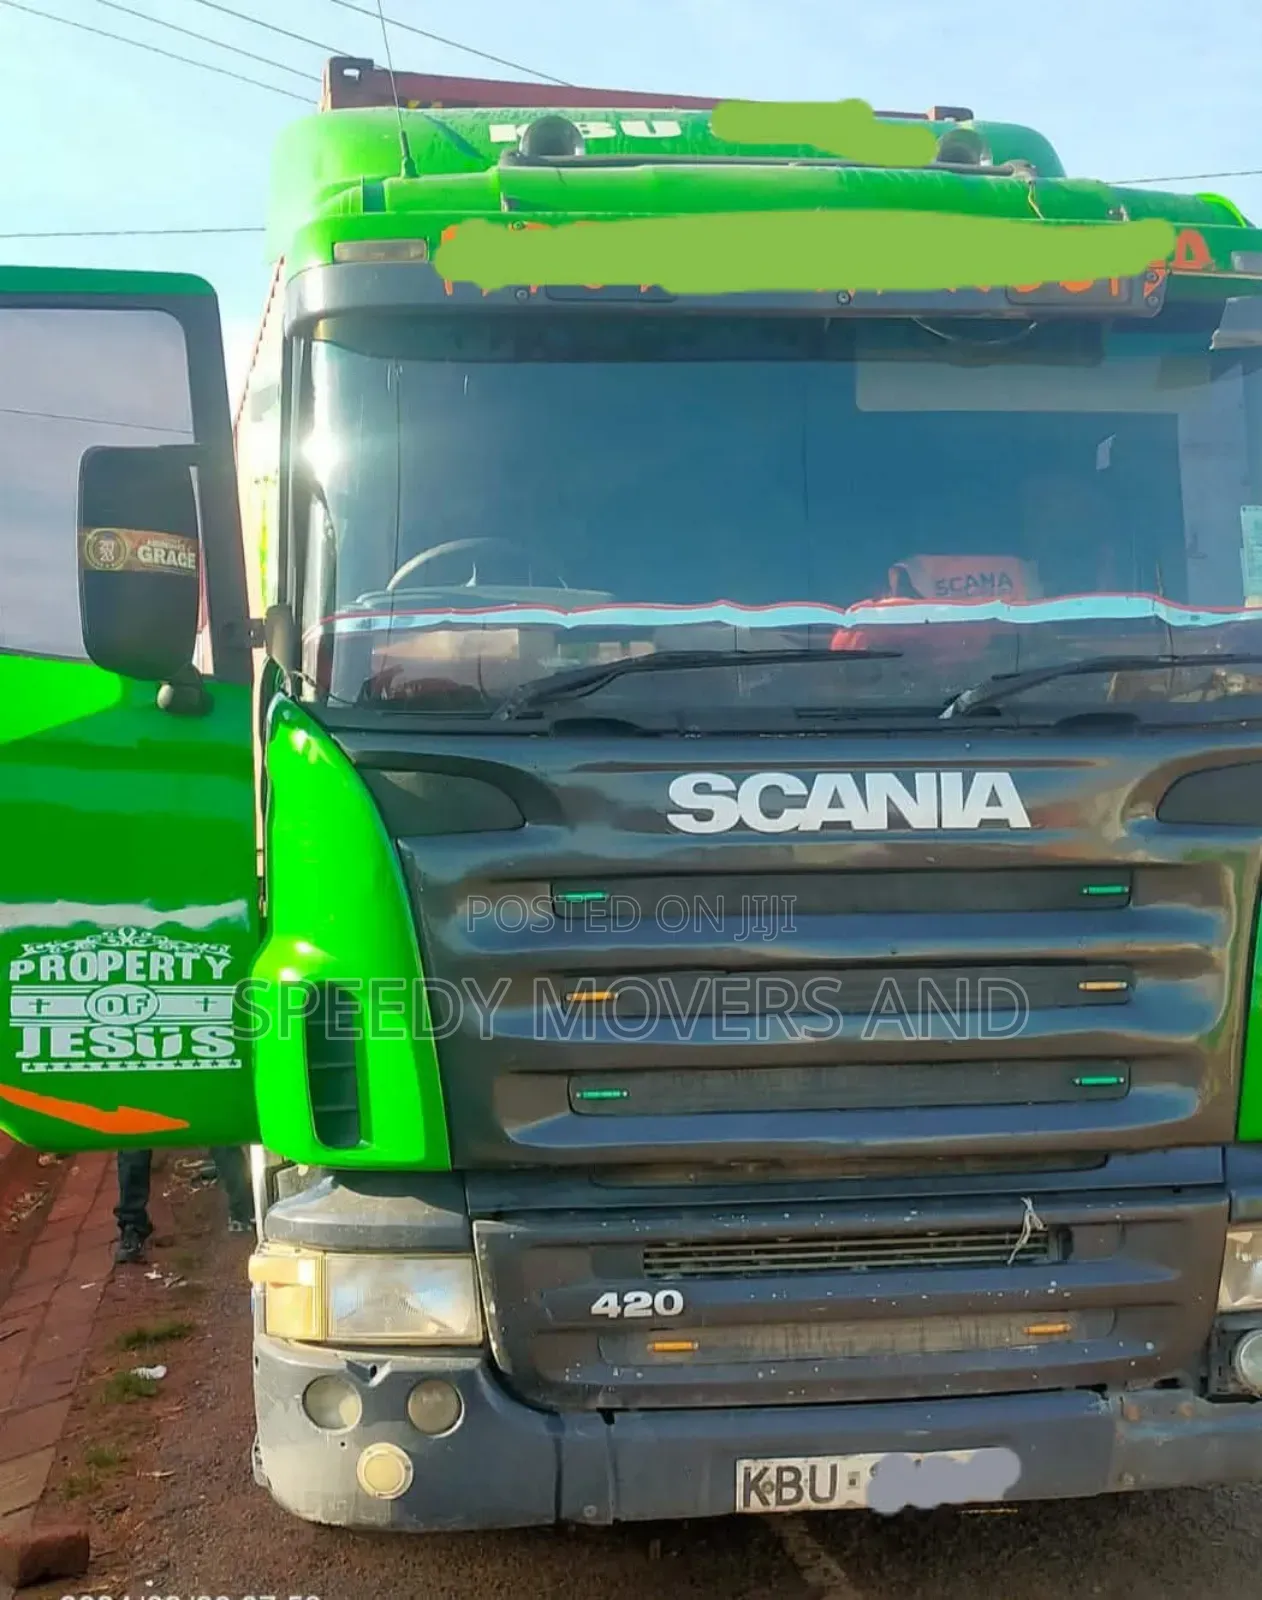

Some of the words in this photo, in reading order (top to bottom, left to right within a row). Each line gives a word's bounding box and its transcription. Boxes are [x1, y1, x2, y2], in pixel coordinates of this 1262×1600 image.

[137, 545, 196, 569] GRACE
[666, 771, 1031, 834] SCANIA
[9, 949, 232, 982] PROPERTY
[94, 993, 151, 1016] OF
[15, 1026, 236, 1058] JESUS
[590, 1289, 684, 1319] 420
[742, 1463, 838, 1509] KBU
